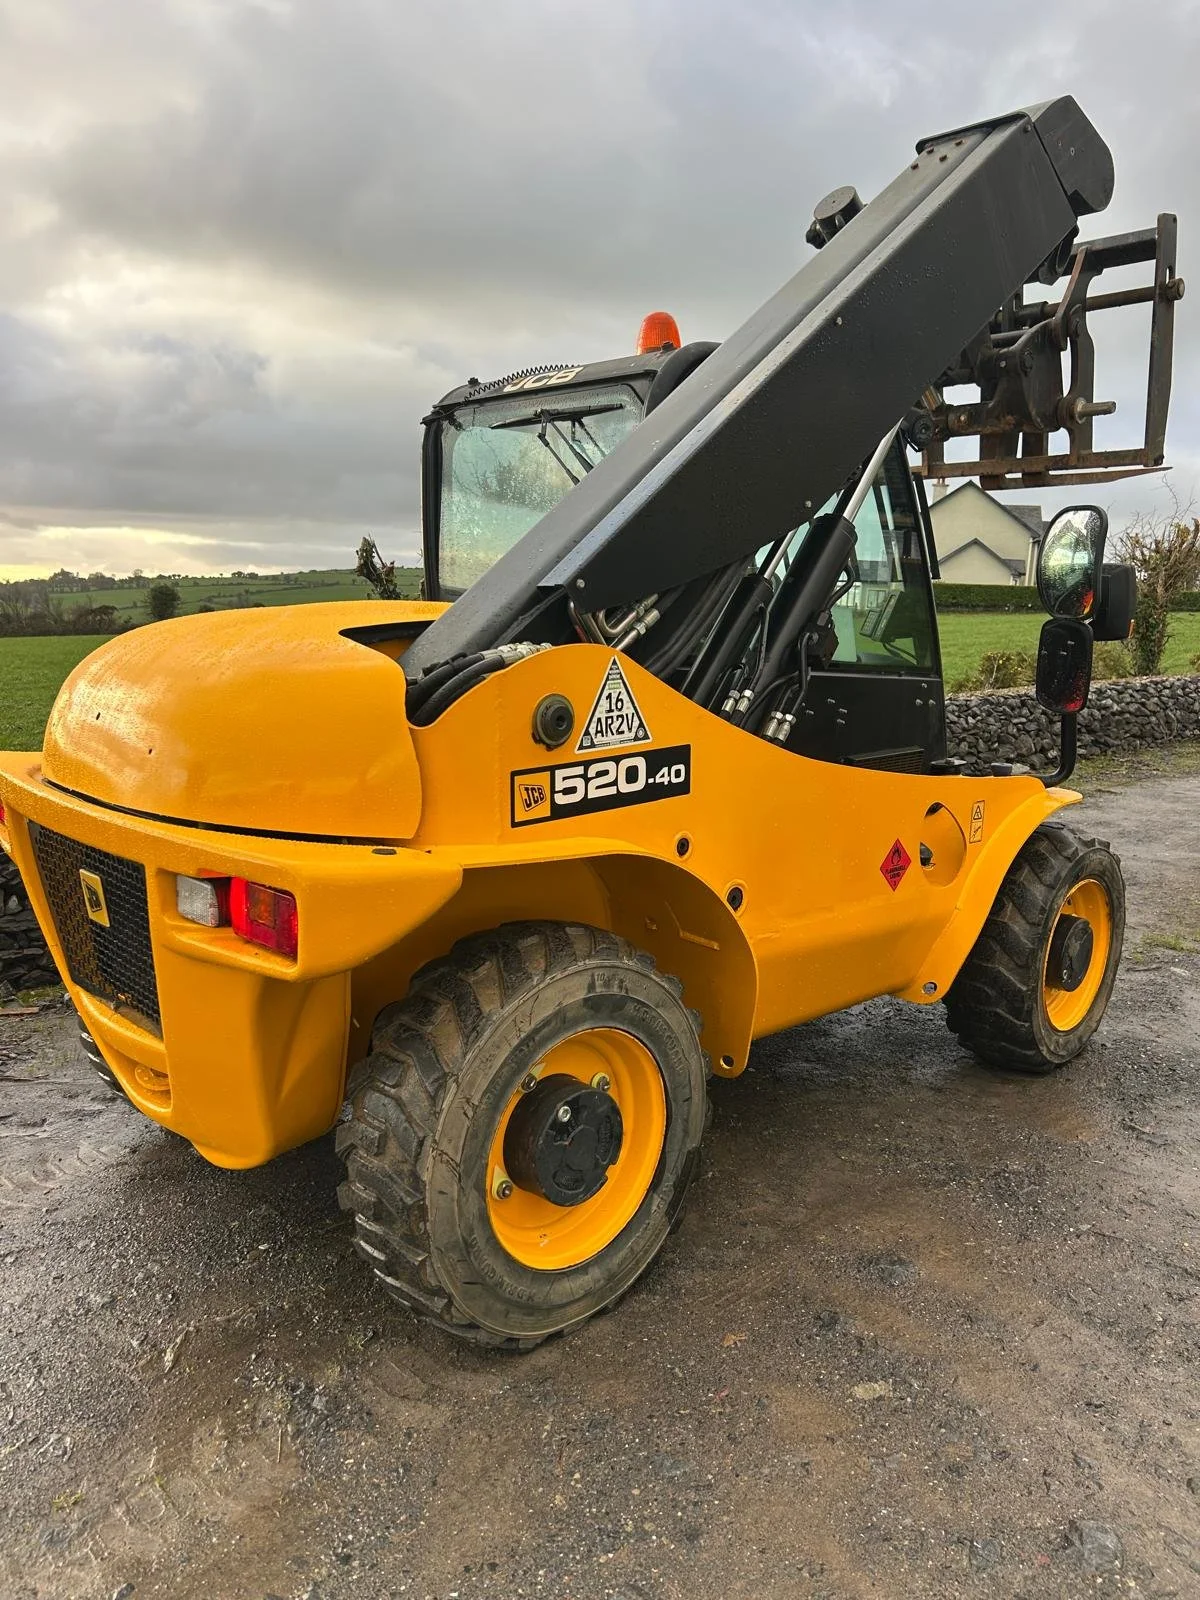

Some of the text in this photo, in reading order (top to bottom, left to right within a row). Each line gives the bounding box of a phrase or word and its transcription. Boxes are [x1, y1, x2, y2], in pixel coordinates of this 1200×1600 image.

[503, 366, 584, 392] JCB
[605, 691, 624, 714] 16
[595, 713, 634, 738] AR2V
[523, 757, 685, 810] JCB 520-40
